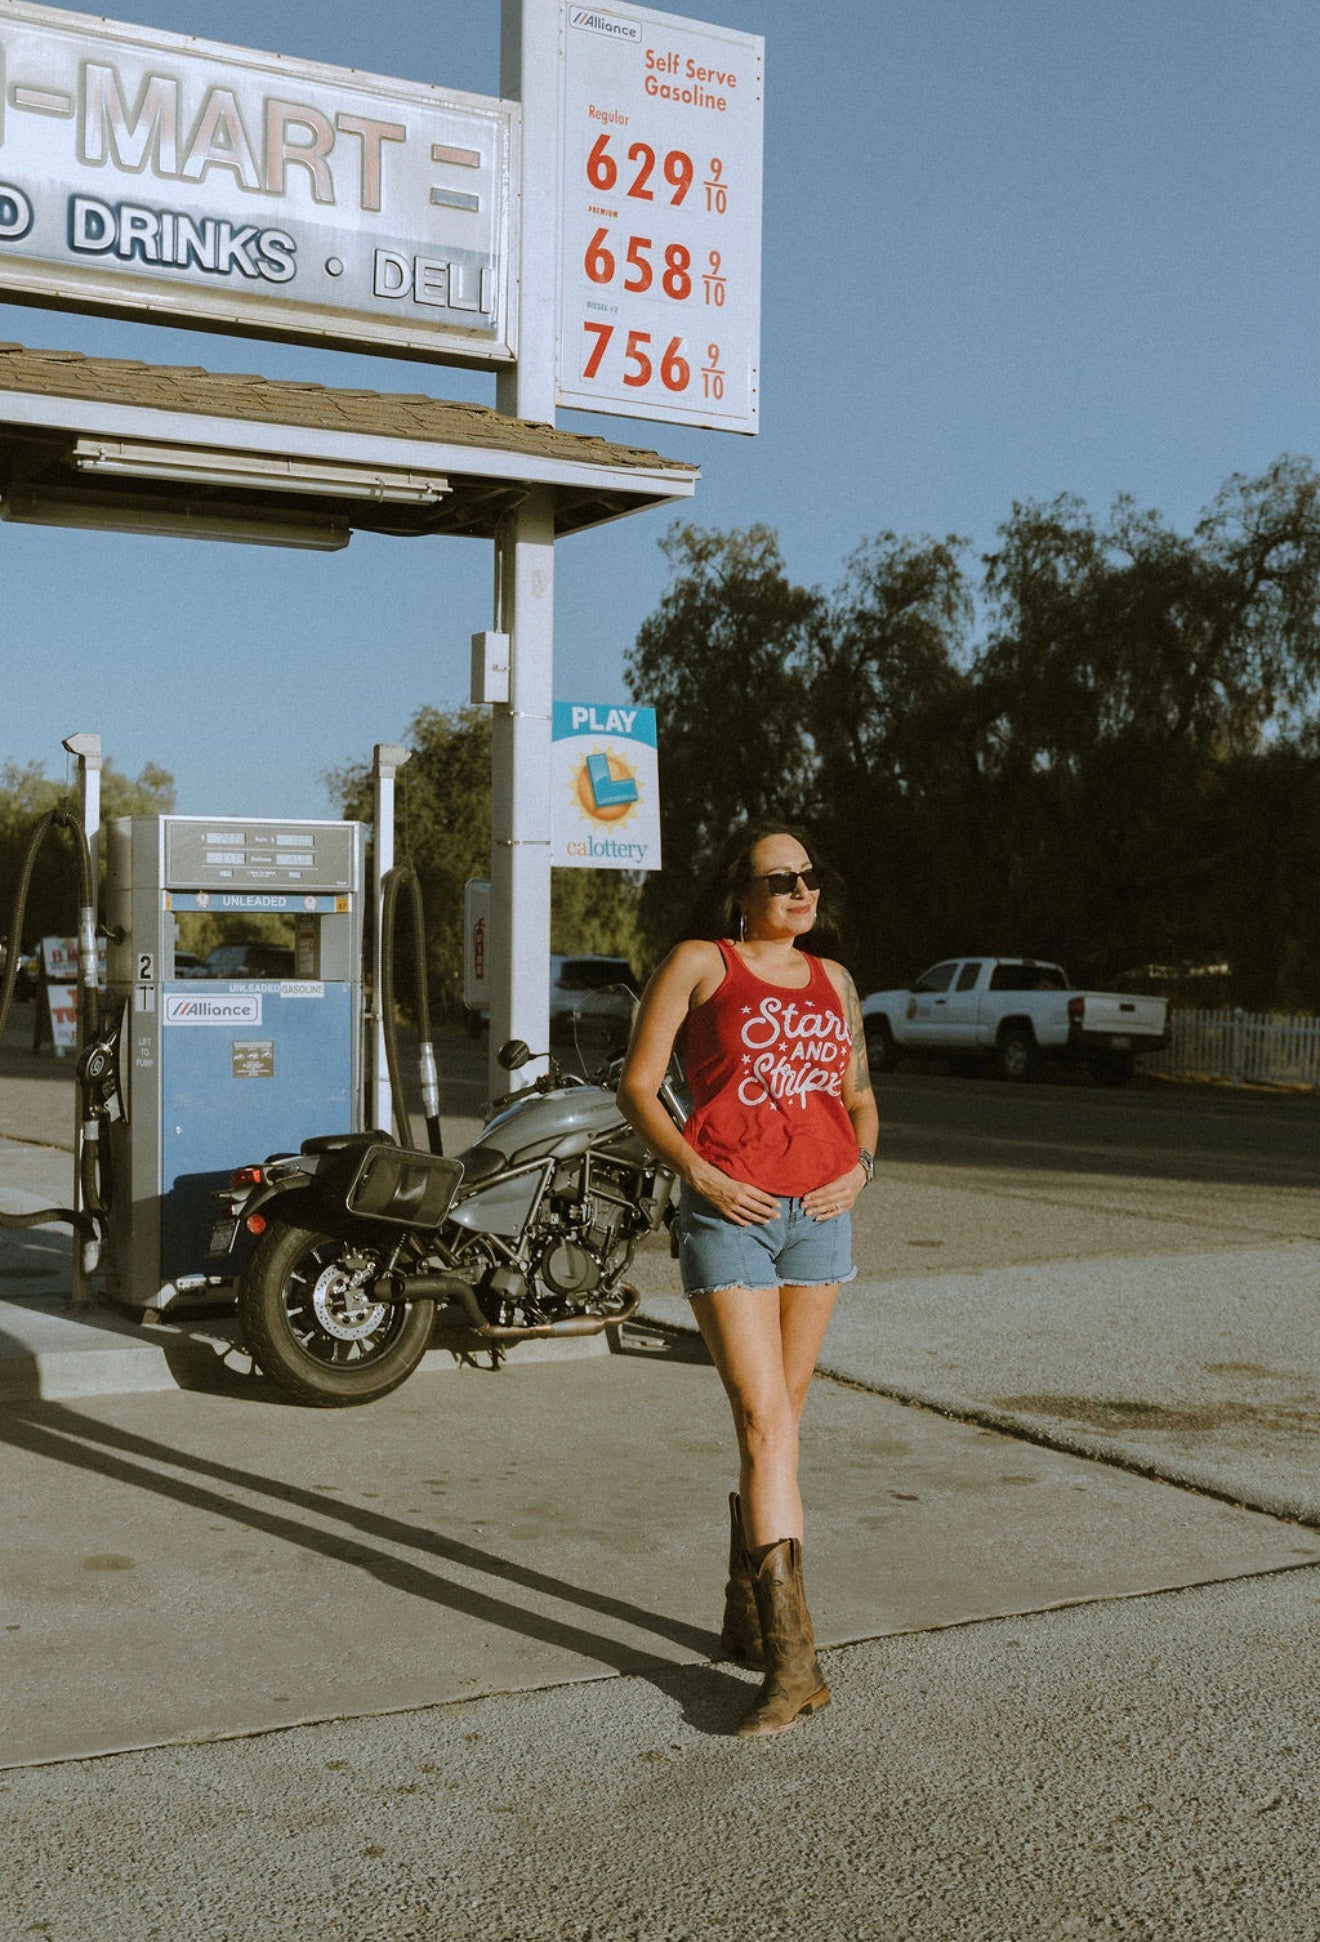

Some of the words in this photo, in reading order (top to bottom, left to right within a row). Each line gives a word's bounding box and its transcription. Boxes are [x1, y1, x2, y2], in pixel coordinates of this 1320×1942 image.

[584, 14, 637, 38] Alliance
[645, 49, 680, 75] Self
[686, 58, 737, 88] Serve
[644, 75, 727, 112] Gasoline
[588, 104, 629, 126] Regular
[0, 56, 406, 212] -MART
[586, 133, 694, 207] 629
[588, 205, 618, 218] PREMIUM
[69, 192, 298, 284] DRINKS
[373, 248, 492, 315] DELI
[584, 227, 692, 300] 658
[582, 321, 691, 392] 756
[571, 706, 638, 732] PLAY
[567, 836, 648, 863] calottery
[222, 895, 287, 907] UNLEADED
[140, 956, 152, 978] 2
[229, 984, 281, 993] UNLEADED
[281, 985, 324, 994] GASOLINE
[186, 1002, 251, 1016] Alliance
[790, 1041, 838, 1062] AND
[738, 1052, 842, 1109] Stripe
